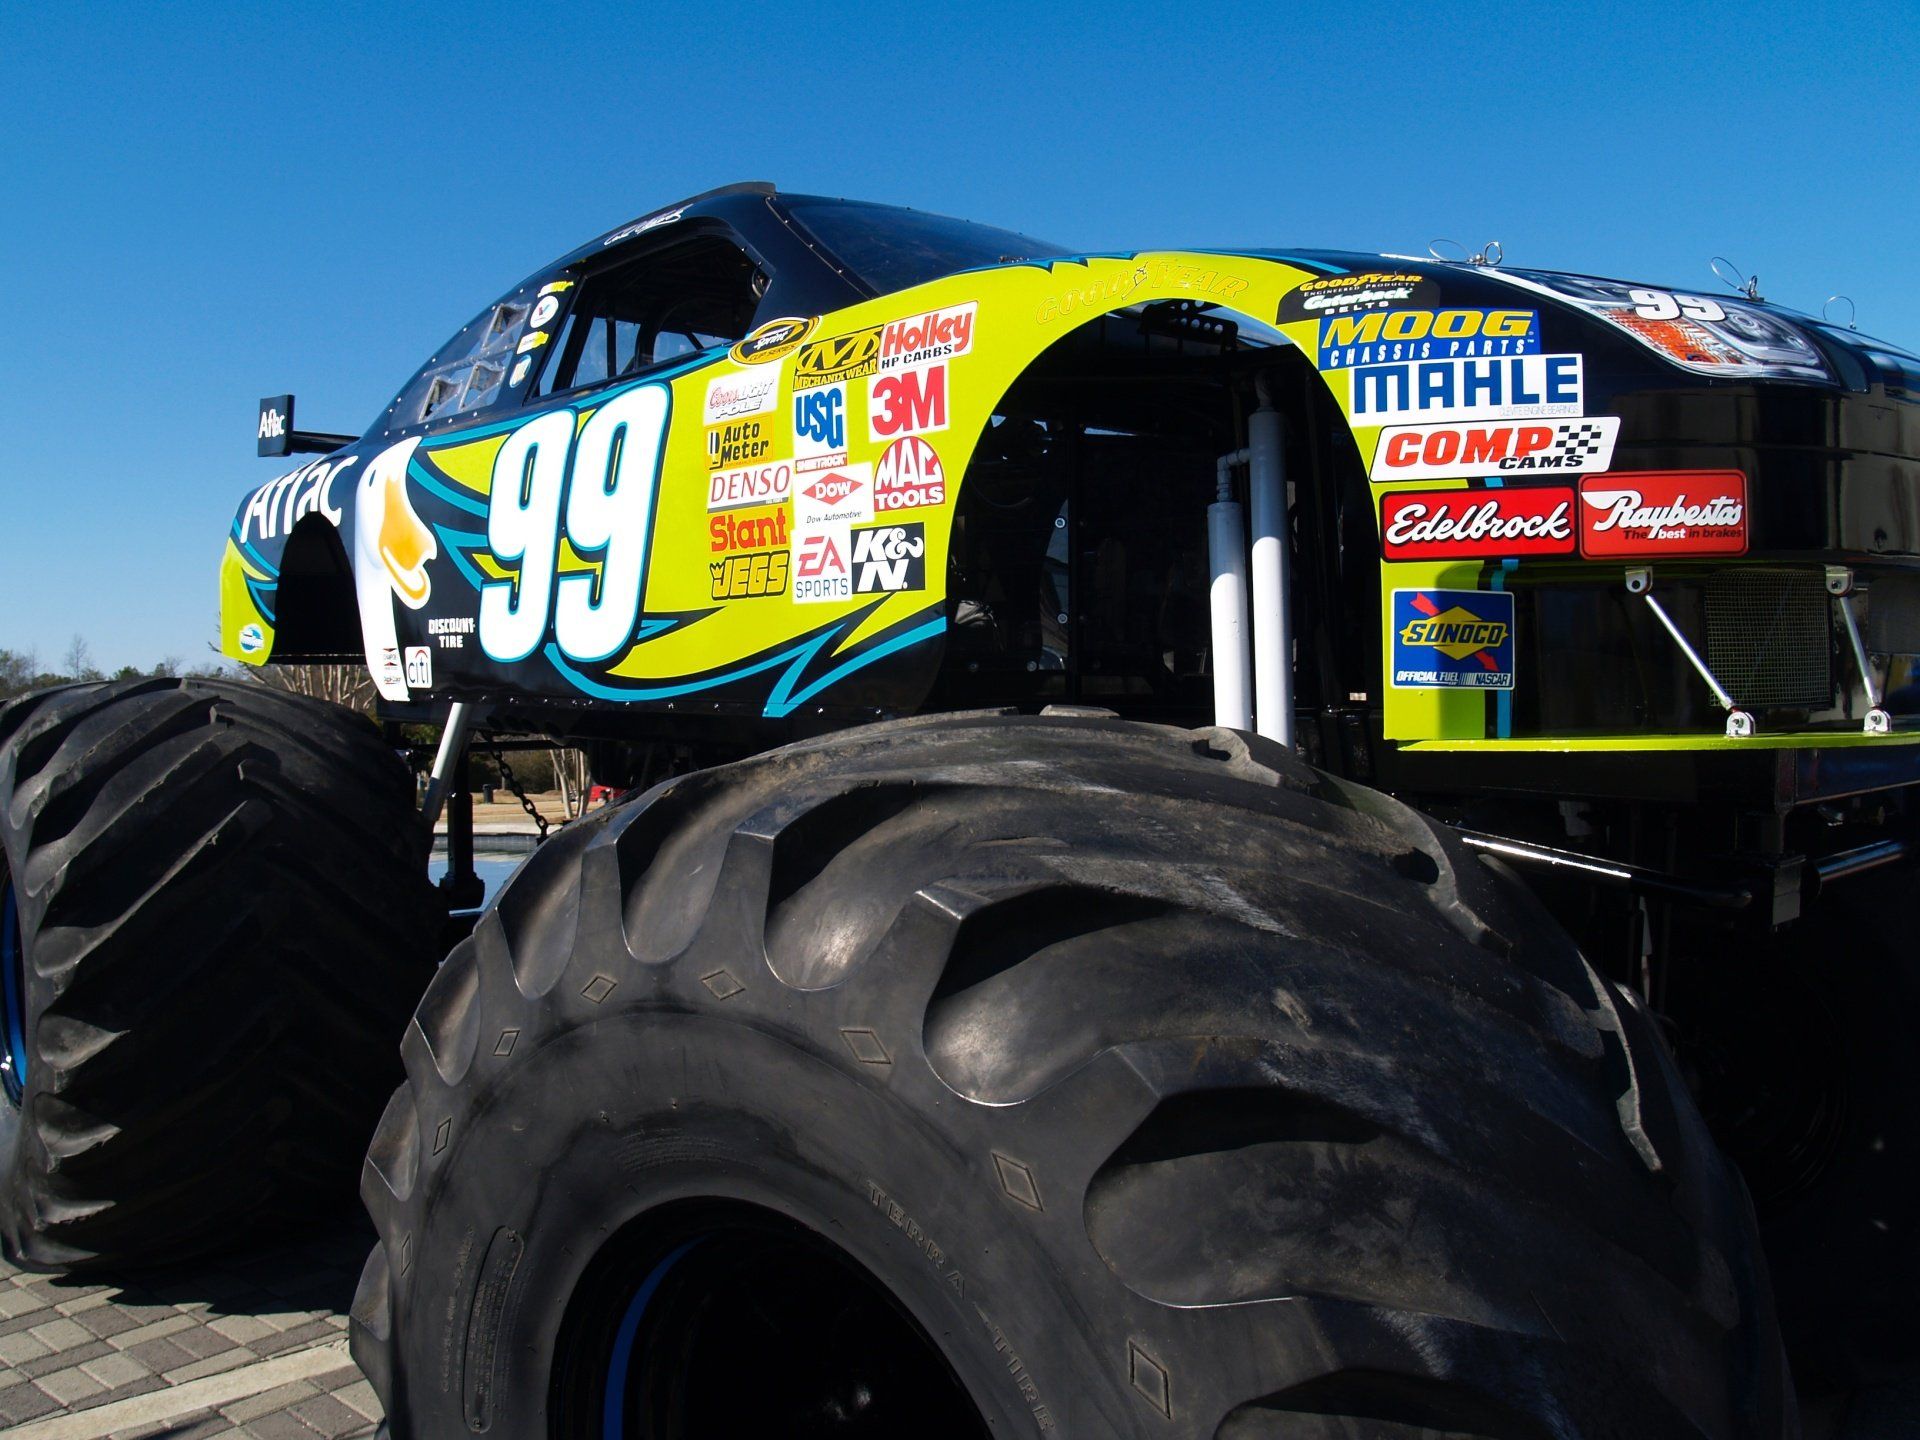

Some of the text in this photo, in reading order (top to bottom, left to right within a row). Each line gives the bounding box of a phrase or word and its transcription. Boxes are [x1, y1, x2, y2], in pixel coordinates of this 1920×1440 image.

[1300, 273, 1422, 291] GOODYEAR
[1304, 281, 1415, 297] ENGINEERED PRODUCTS
[1324, 301, 1389, 315] BELTS
[1629, 289, 1726, 322] 99
[883, 312, 973, 357] Holley
[1322, 310, 1534, 348] MOOG
[882, 344, 952, 370] HP CARBS
[1330, 338, 1525, 368] CHASSIS PARTS
[794, 359, 877, 389] MECHANIX WEAR
[1354, 356, 1578, 414] MAHLE
[872, 365, 945, 435] 3M
[258, 408, 285, 439] Aflac
[723, 422, 760, 444] Auto
[795, 387, 843, 449] USG
[721, 439, 769, 463] Meter
[1384, 426, 1554, 467] COMP
[875, 437, 944, 490] MAC
[1499, 454, 1585, 470] CAMS
[711, 465, 790, 502] DENSO
[814, 481, 852, 499] DOW
[875, 485, 944, 511] TOOLS
[240, 455, 358, 543] Aflac
[479, 383, 671, 662] 99
[710, 507, 787, 552] Stant
[806, 510, 863, 524] Dow Automotive
[1386, 500, 1571, 545] Edelbrock
[1581, 490, 1743, 539] Raybestos
[1623, 527, 1742, 540] The best in brakes
[797, 535, 846, 577] EA
[710, 550, 790, 600] JEGS
[796, 578, 848, 599] SPORTS
[428, 617, 475, 634] DISCOUNT
[1406, 623, 1504, 644] SUNOCO
[439, 635, 464, 648] TIRE
[1396, 671, 1509, 685] OFFICIAL FUEL NASCAR
